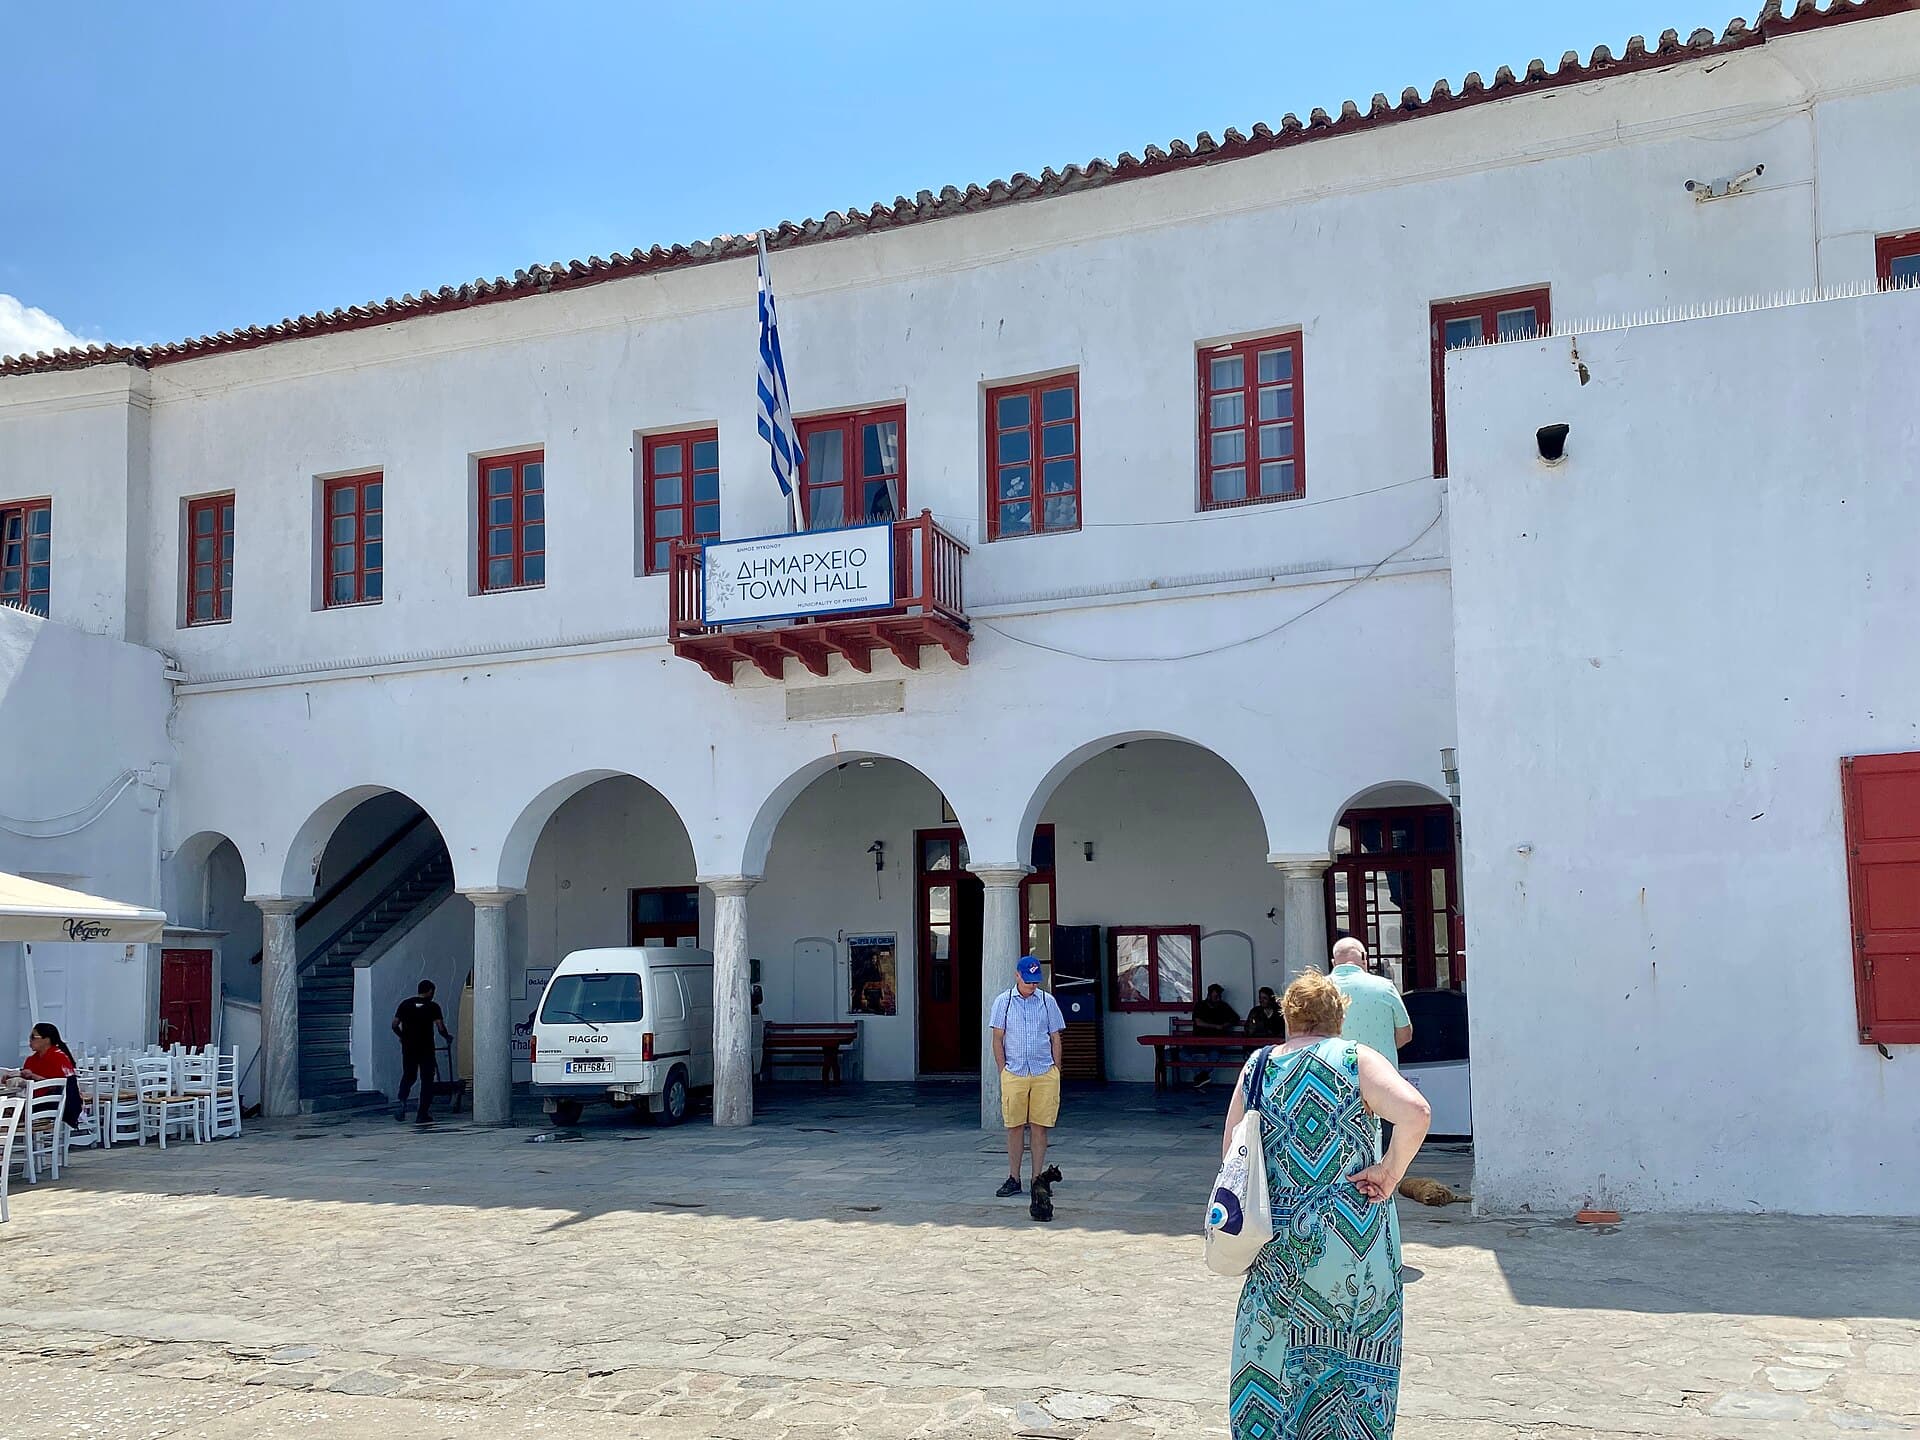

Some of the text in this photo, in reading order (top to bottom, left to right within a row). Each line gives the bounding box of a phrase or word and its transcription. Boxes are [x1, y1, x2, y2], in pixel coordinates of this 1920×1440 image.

[737, 548, 867, 580] ΔΗΜΑΡΧΕΙΟ
[737, 571, 867, 601] TOWN HALL
[797, 600, 832, 608] MUNICIPALITY
[511, 1039, 530, 1050] Thal
[568, 1034, 609, 1044] PIAGGIO
